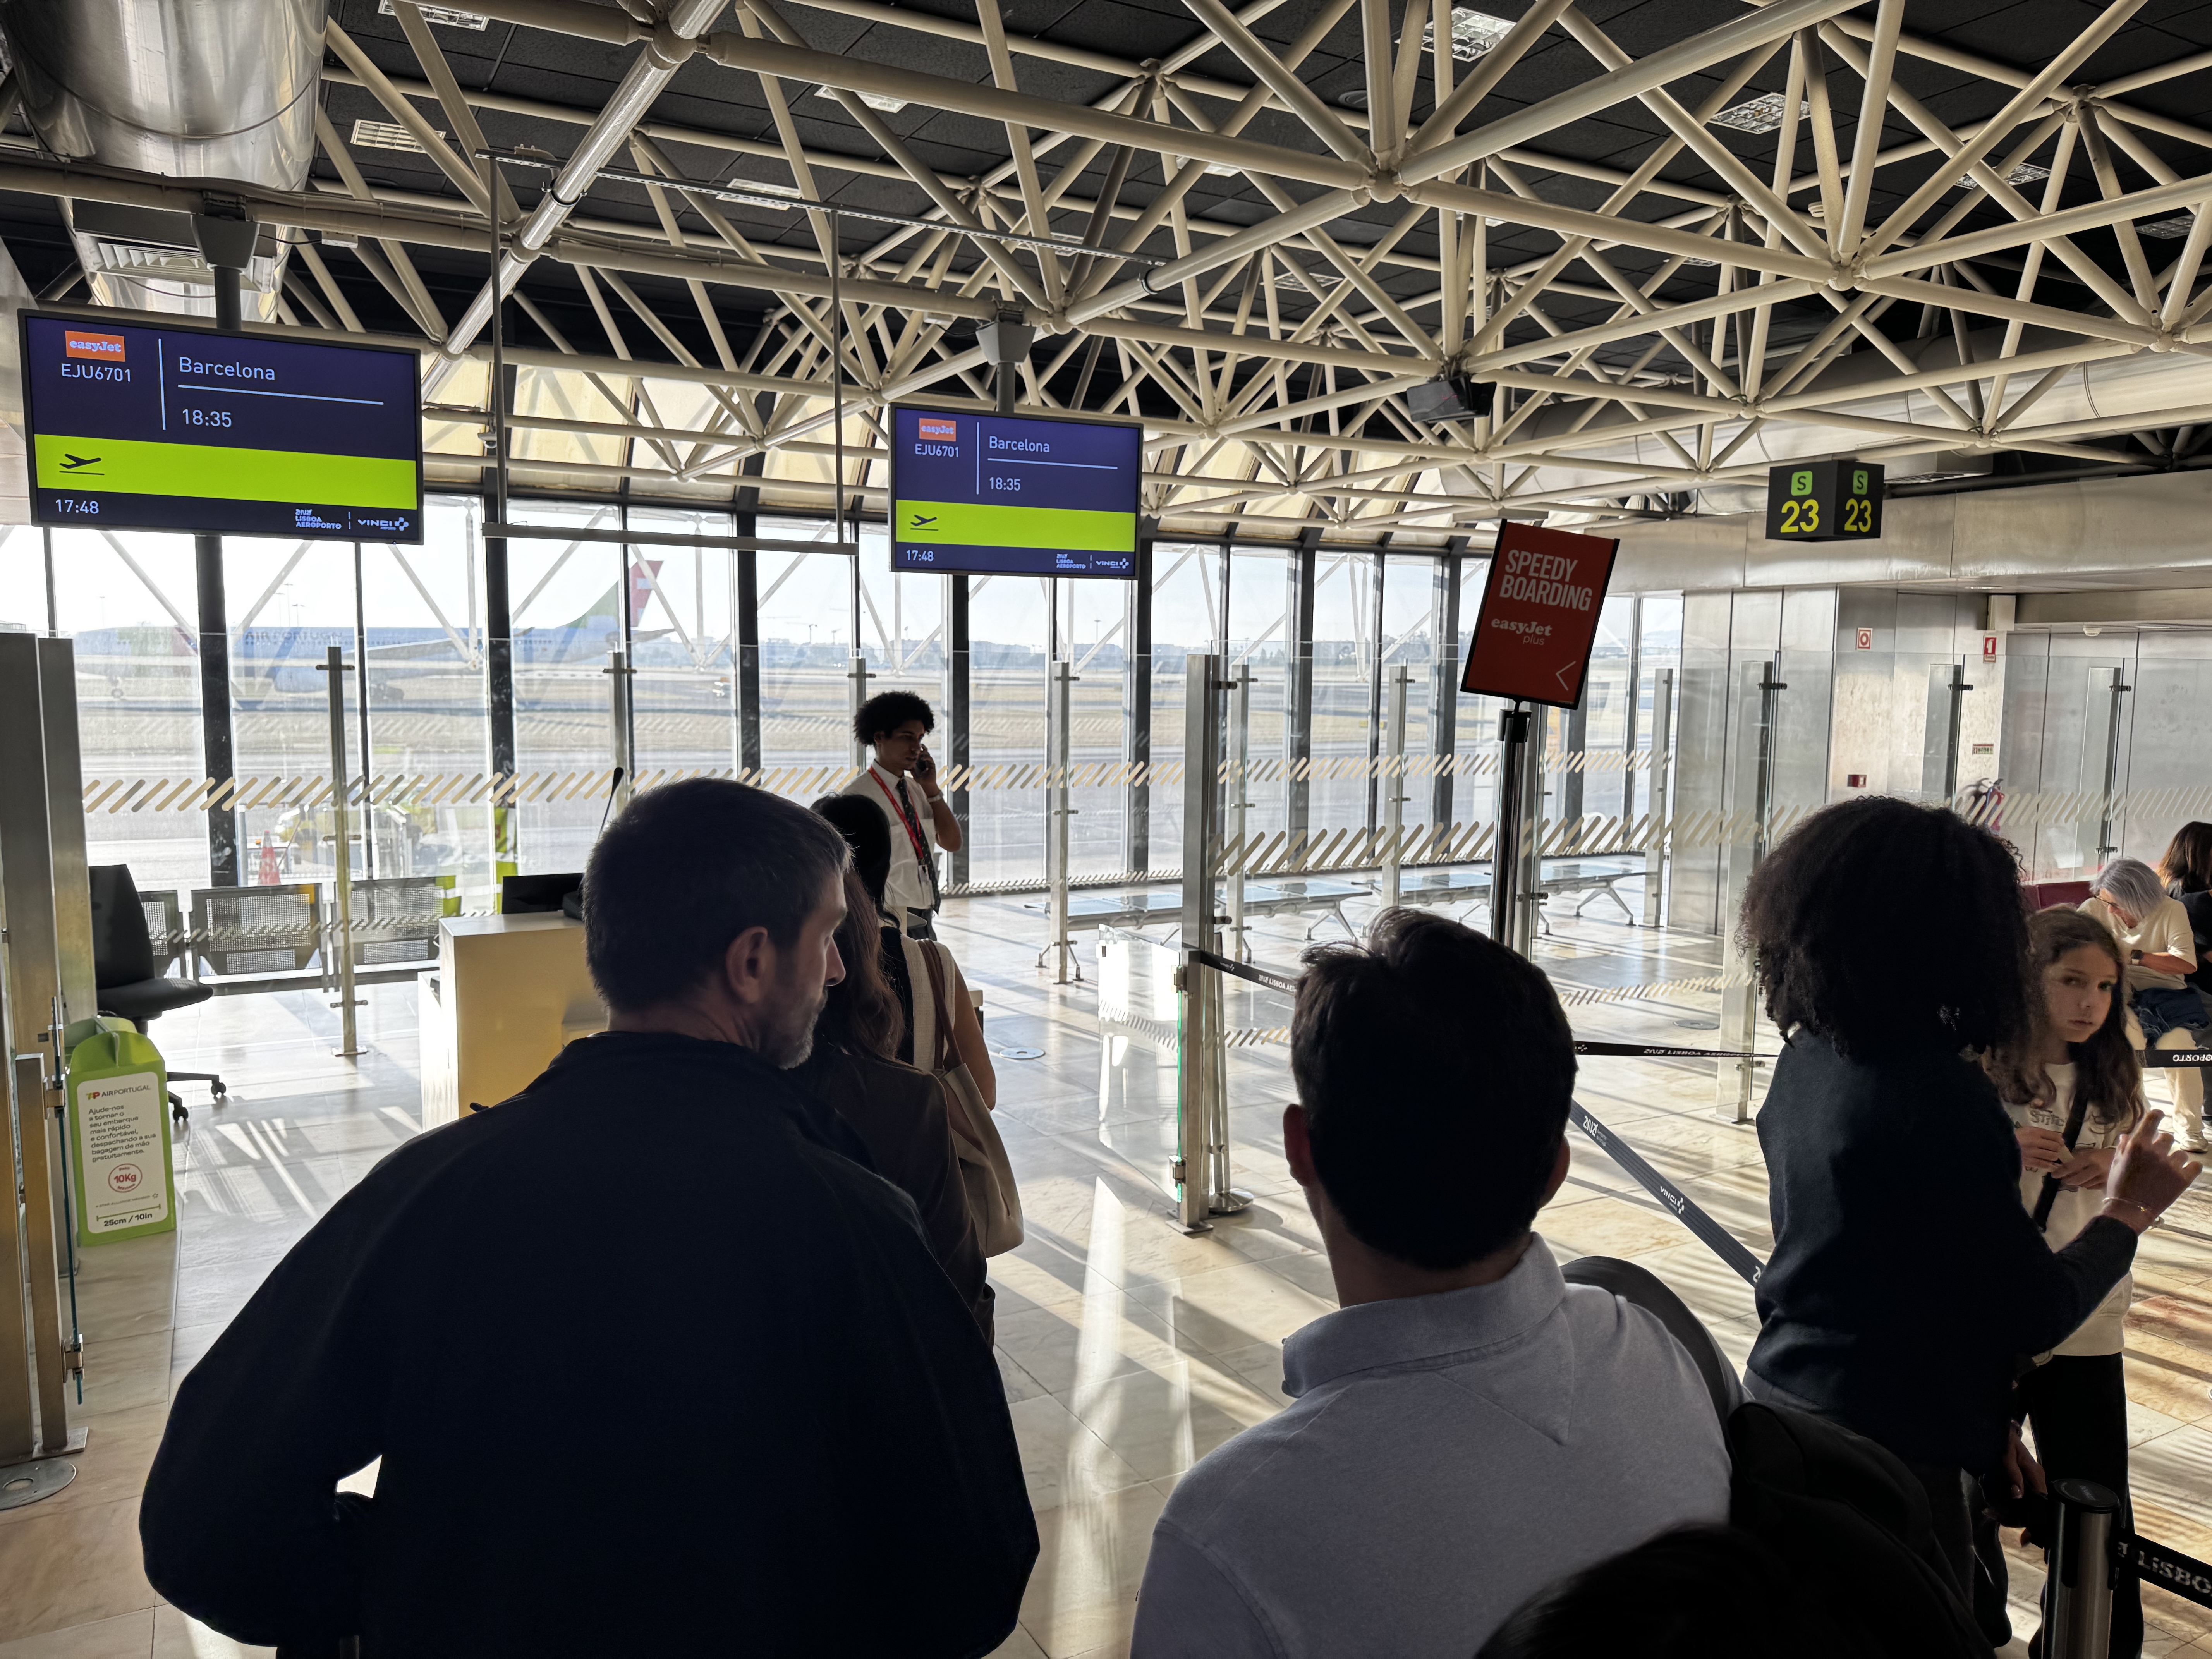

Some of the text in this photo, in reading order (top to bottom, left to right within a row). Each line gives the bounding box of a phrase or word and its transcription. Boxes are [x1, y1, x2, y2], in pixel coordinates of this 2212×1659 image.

[69, 340, 122, 354] easyJet
[61, 363, 132, 382] EJU6701
[179, 356, 275, 380] Barcelona
[182, 408, 232, 428] 18:35
[921, 425, 954, 435] easyJet
[915, 443, 960, 457] EJU6701
[989, 436, 1050, 453] Barcelona
[989, 477, 1021, 491] 18:35
[1796, 475, 1807, 491] S
[1856, 474, 1864, 490] S
[55, 498, 100, 514] 17:48
[1780, 499, 1819, 533] 23
[1844, 498, 1872, 532] 23
[906, 550, 934, 562] 17:48
[1505, 549, 1578, 582] SPEEDY
[1499, 574, 1592, 611] BOARDING
[1491, 618, 1553, 636] easyJet
[1522, 634, 1545, 646] plus
[88, 1104, 124, 1115] Ajude-nos
[103, 1116, 139, 1126] embarque
[2030, 1109, 2065, 1127] STITC
[96, 1129, 139, 1141] confortável,
[108, 1124, 131, 1132] rápido
[91, 1136, 137, 1149] despachando
[92, 1146, 124, 1155] bagagem
[92, 1149, 144, 1163] gratuitamente.
[113, 1173, 137, 1183] 10Kg
[1660, 1186, 1677, 1205] VINCI
[104, 1218, 127, 1227] 25cm
[135, 1212, 153, 1221] 10in
[2137, 1549, 2212, 1597] LiSBO
